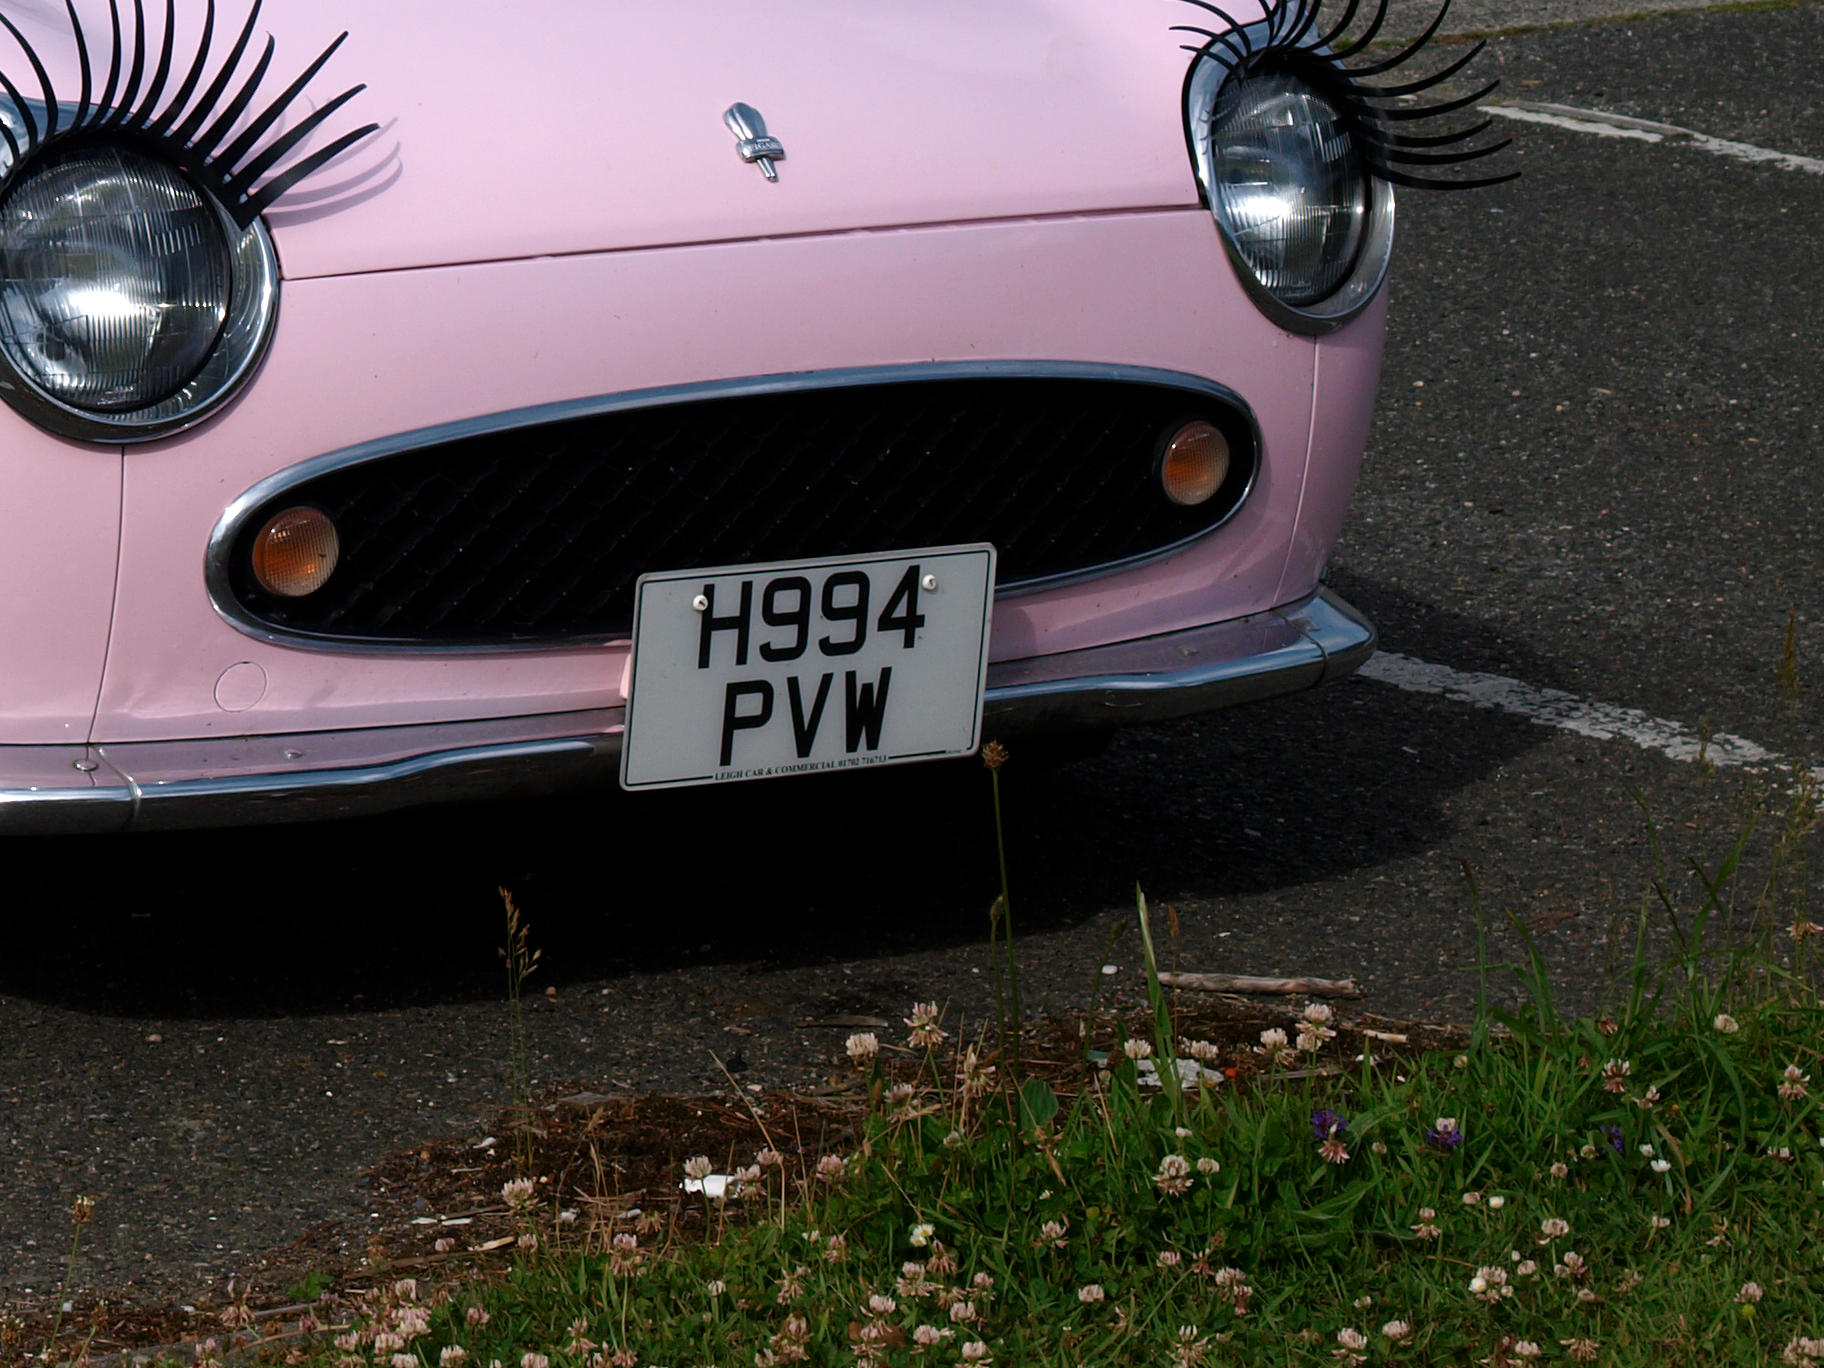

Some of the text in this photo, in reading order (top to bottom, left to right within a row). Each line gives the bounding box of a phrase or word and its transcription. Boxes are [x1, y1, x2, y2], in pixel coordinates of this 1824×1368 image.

[697, 564, 926, 669] H994
[719, 666, 893, 767] PVW
[715, 770, 743, 781] LEIGH
[745, 768, 764, 778] CAR
[765, 767, 773, 776] &
[775, 760, 835, 774] COMMERCIAL
